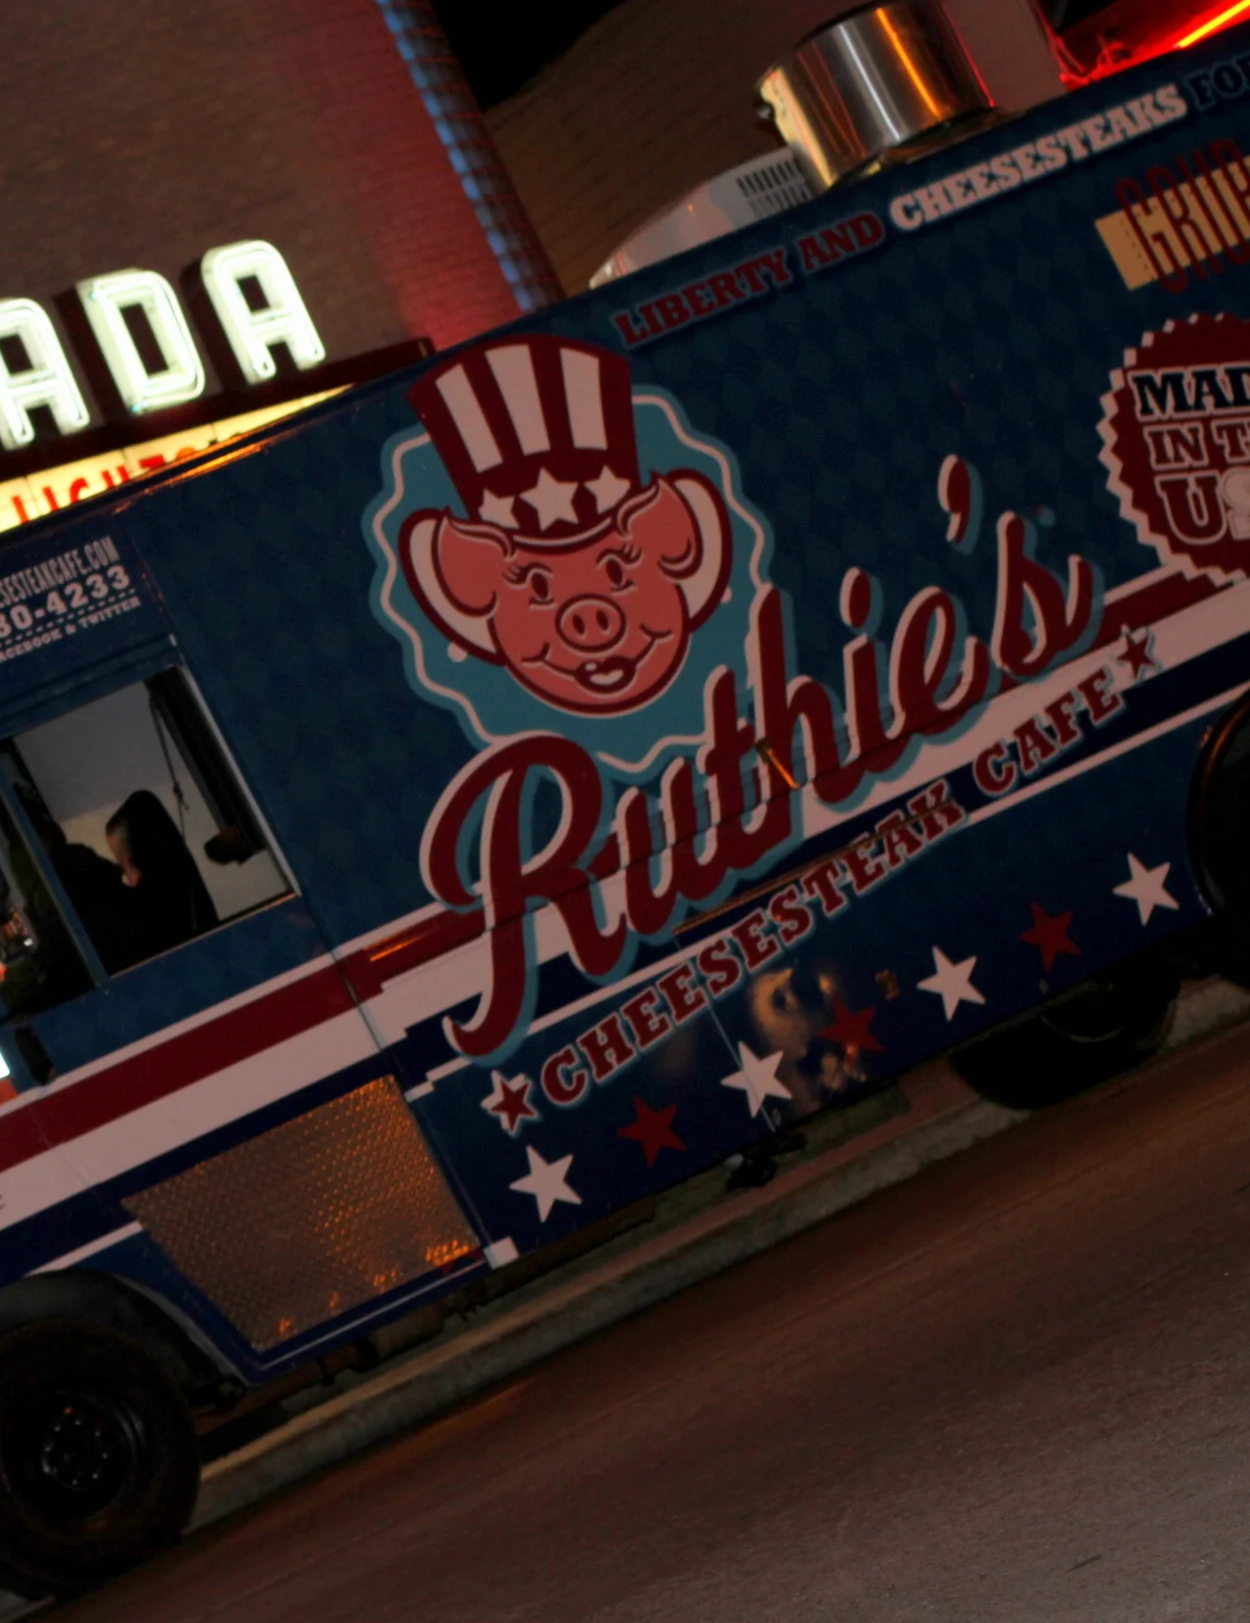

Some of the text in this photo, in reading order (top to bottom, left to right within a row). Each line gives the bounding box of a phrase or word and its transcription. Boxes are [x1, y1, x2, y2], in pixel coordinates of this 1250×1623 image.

[614, 247, 792, 347] LIBERTY
[796, 210, 885, 274] AND
[888, 84, 1188, 232] CHEESESTEAKS
[1143, 421, 1210, 471] IN
[79, 595, 141, 630] TWITTER
[420, 455, 1096, 1062] Ruthie's
[540, 671, 1127, 1107] CHEESESTEAK CAFE
